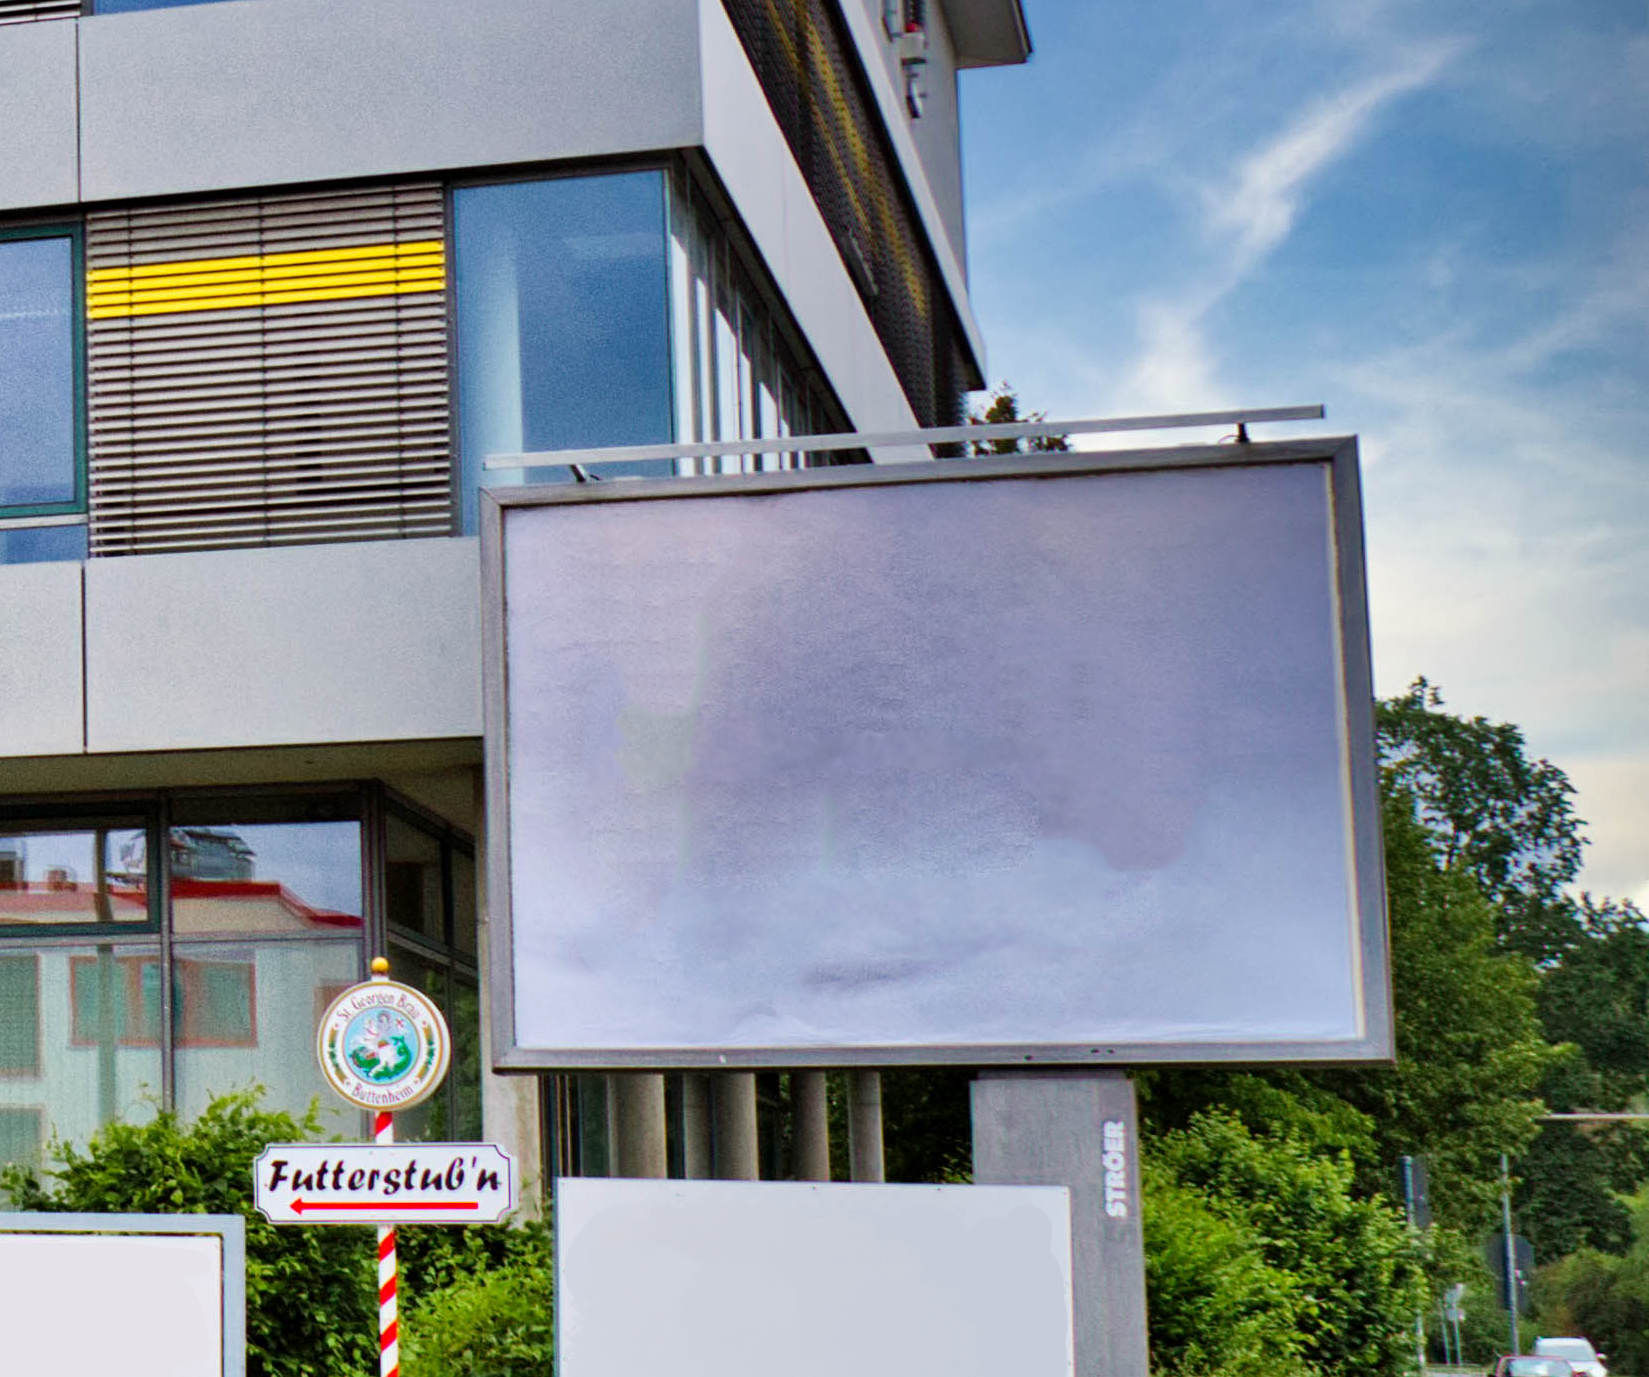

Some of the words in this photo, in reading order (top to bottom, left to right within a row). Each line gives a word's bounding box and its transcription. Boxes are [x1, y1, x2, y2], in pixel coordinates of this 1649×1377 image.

[349, 991, 395, 1010] Georgen
[352, 1084, 414, 1104] Buttenheim
[268, 1157, 502, 1197] Futterstub'n
[1102, 1120, 1127, 1218] STRÖER
